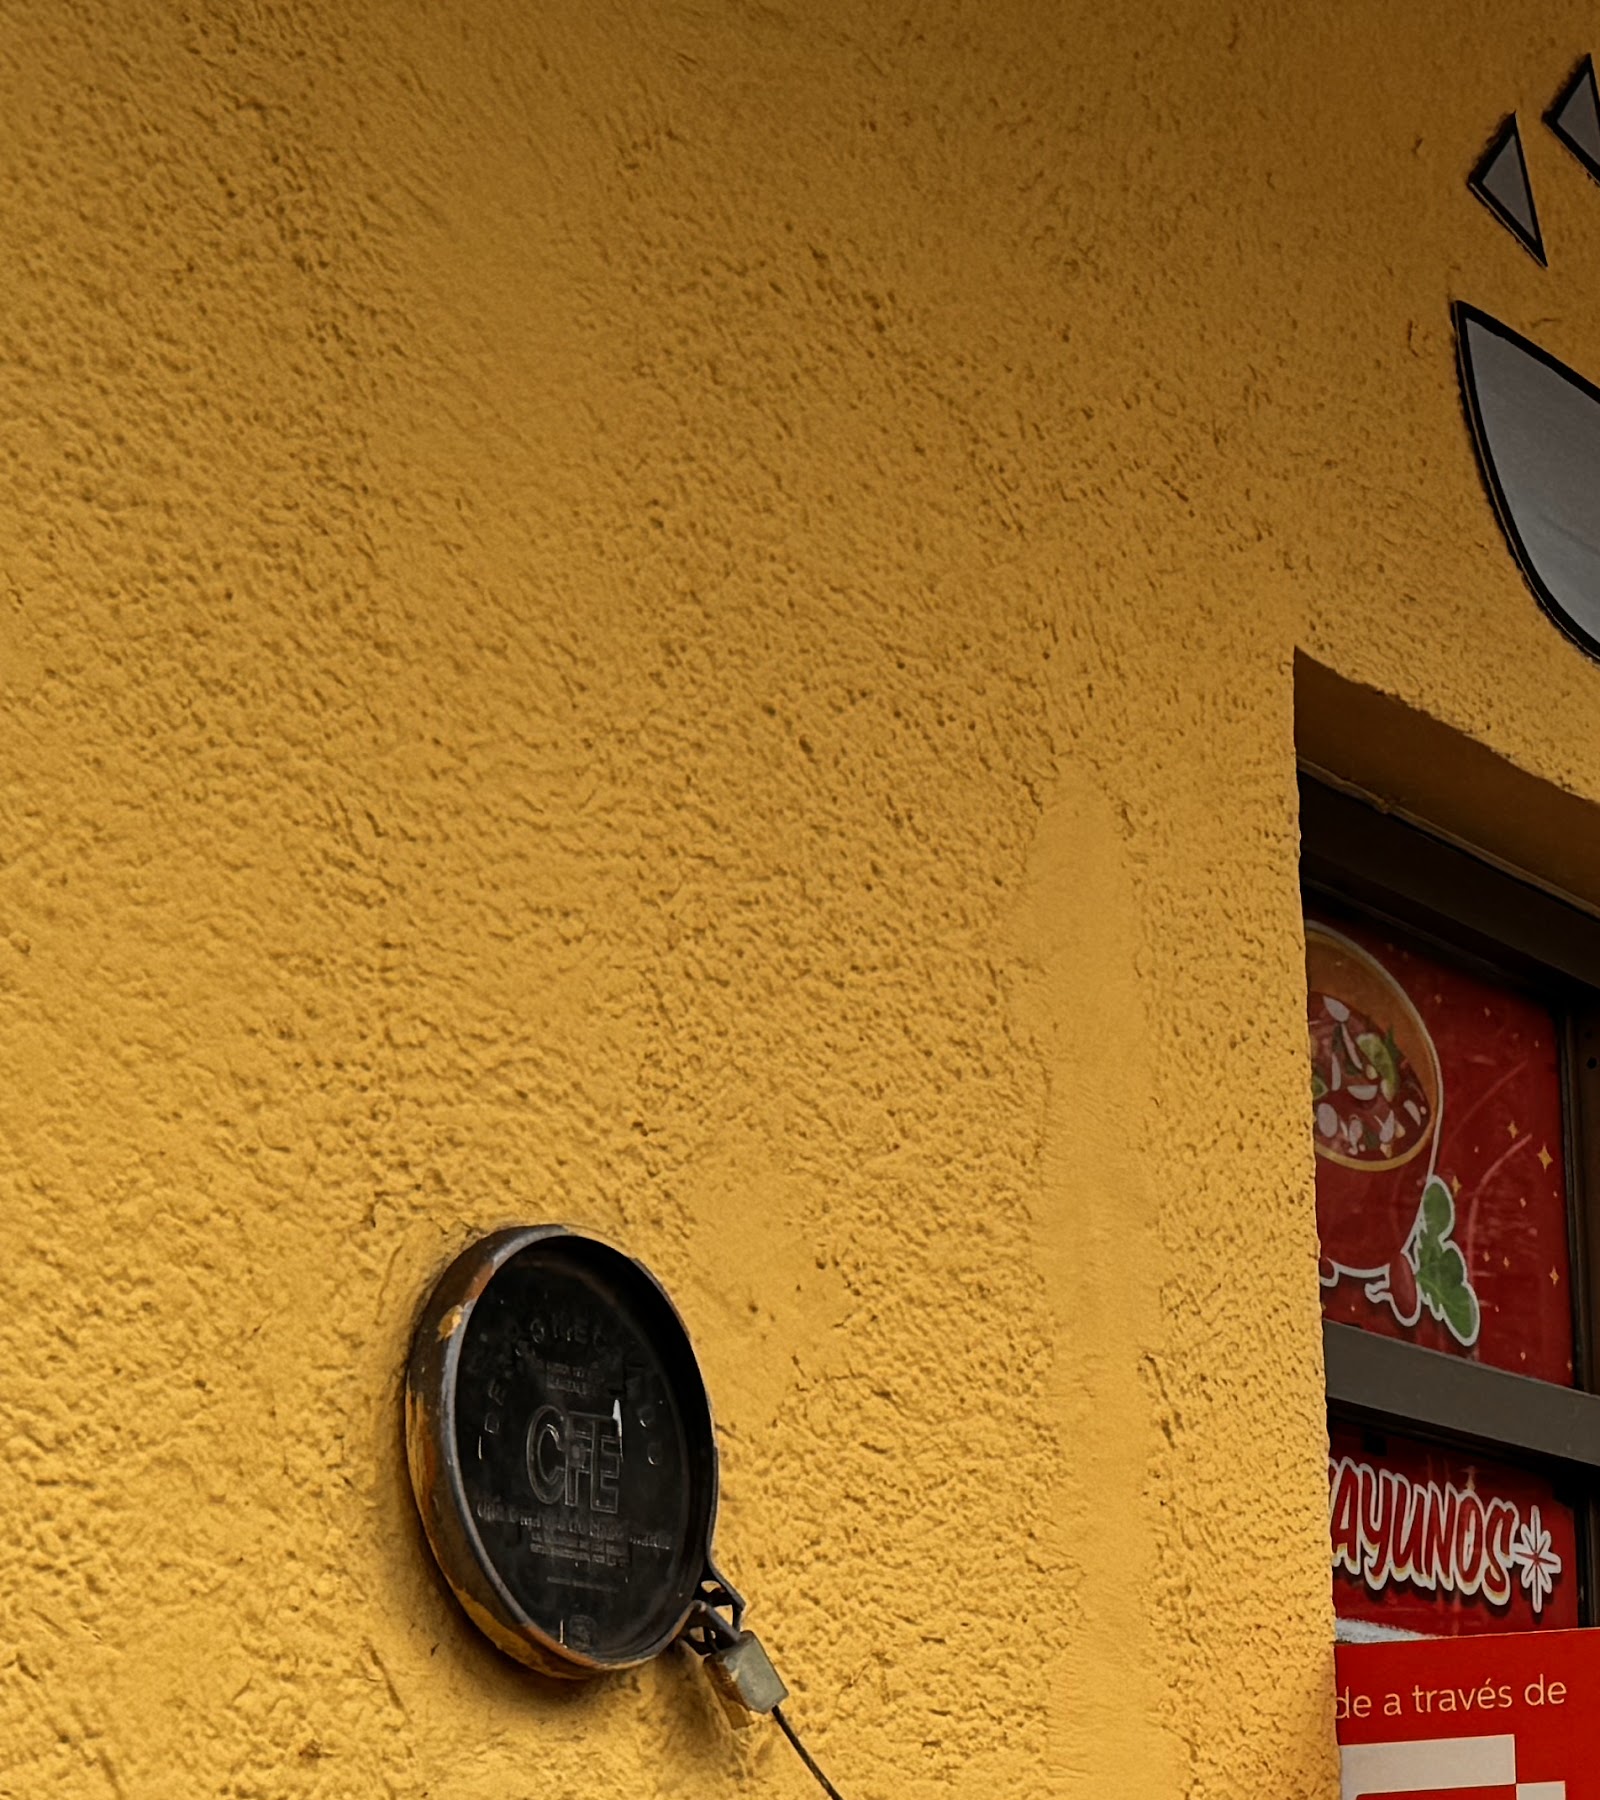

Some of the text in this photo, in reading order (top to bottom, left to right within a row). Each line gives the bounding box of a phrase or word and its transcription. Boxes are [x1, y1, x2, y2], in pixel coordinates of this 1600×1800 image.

[527, 1405, 620, 1514] CFE
[1329, 1455, 1520, 1607] AYUNOS
[1383, 1692, 1402, 1717] a
[1411, 1677, 1514, 1714] través
[1524, 1673, 1568, 1707] de
